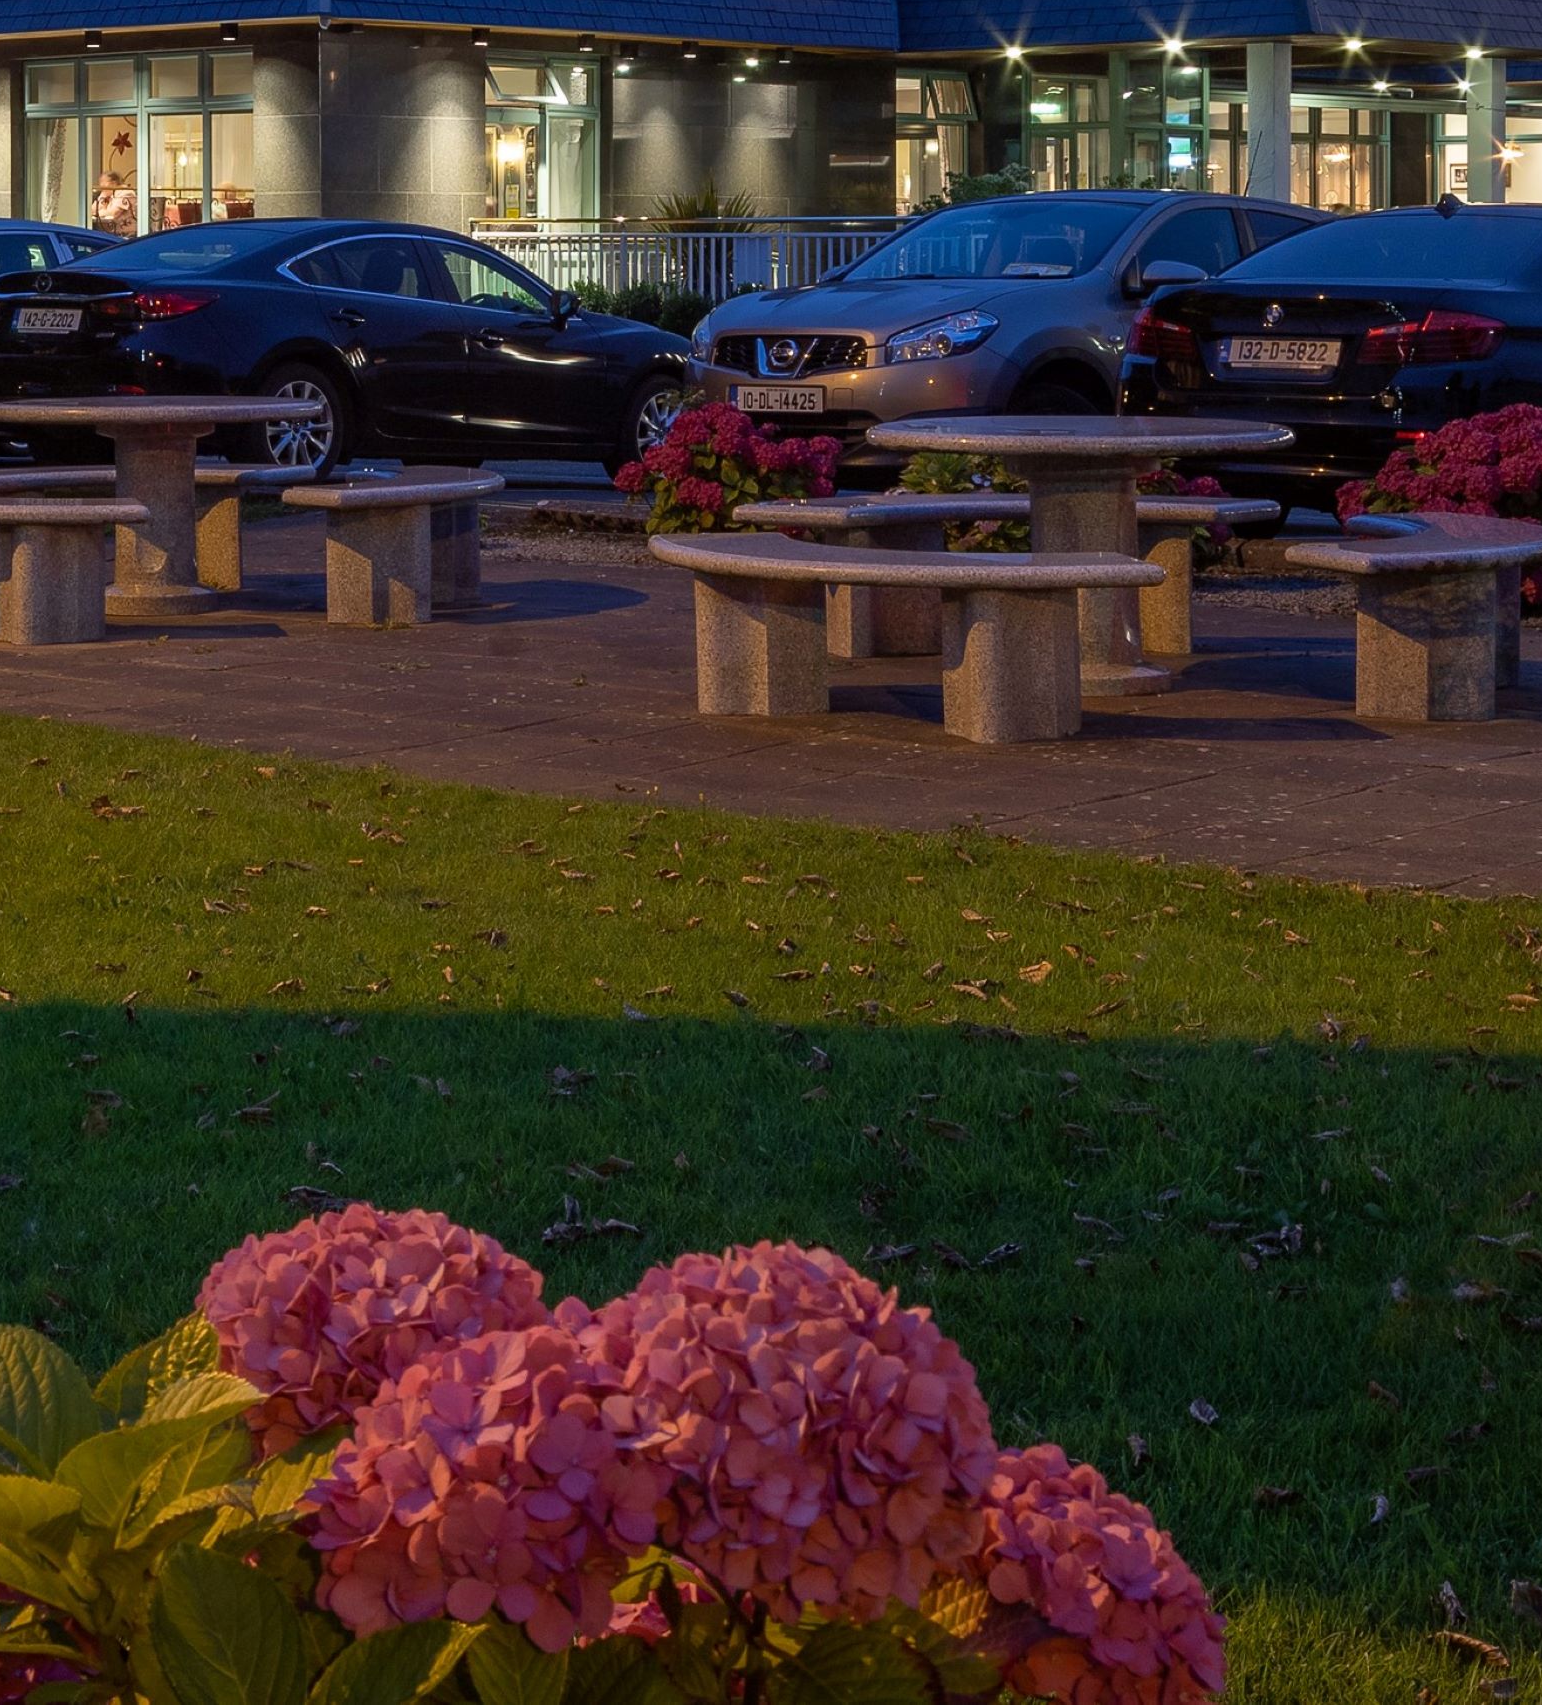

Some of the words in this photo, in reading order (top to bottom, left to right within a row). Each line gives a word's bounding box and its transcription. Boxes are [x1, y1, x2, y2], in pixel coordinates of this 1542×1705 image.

[22, 312, 75, 328] 142-G-2202
[1238, 341, 1328, 362] 132-D-5822
[742, 391, 816, 411] 10-DL-14425
